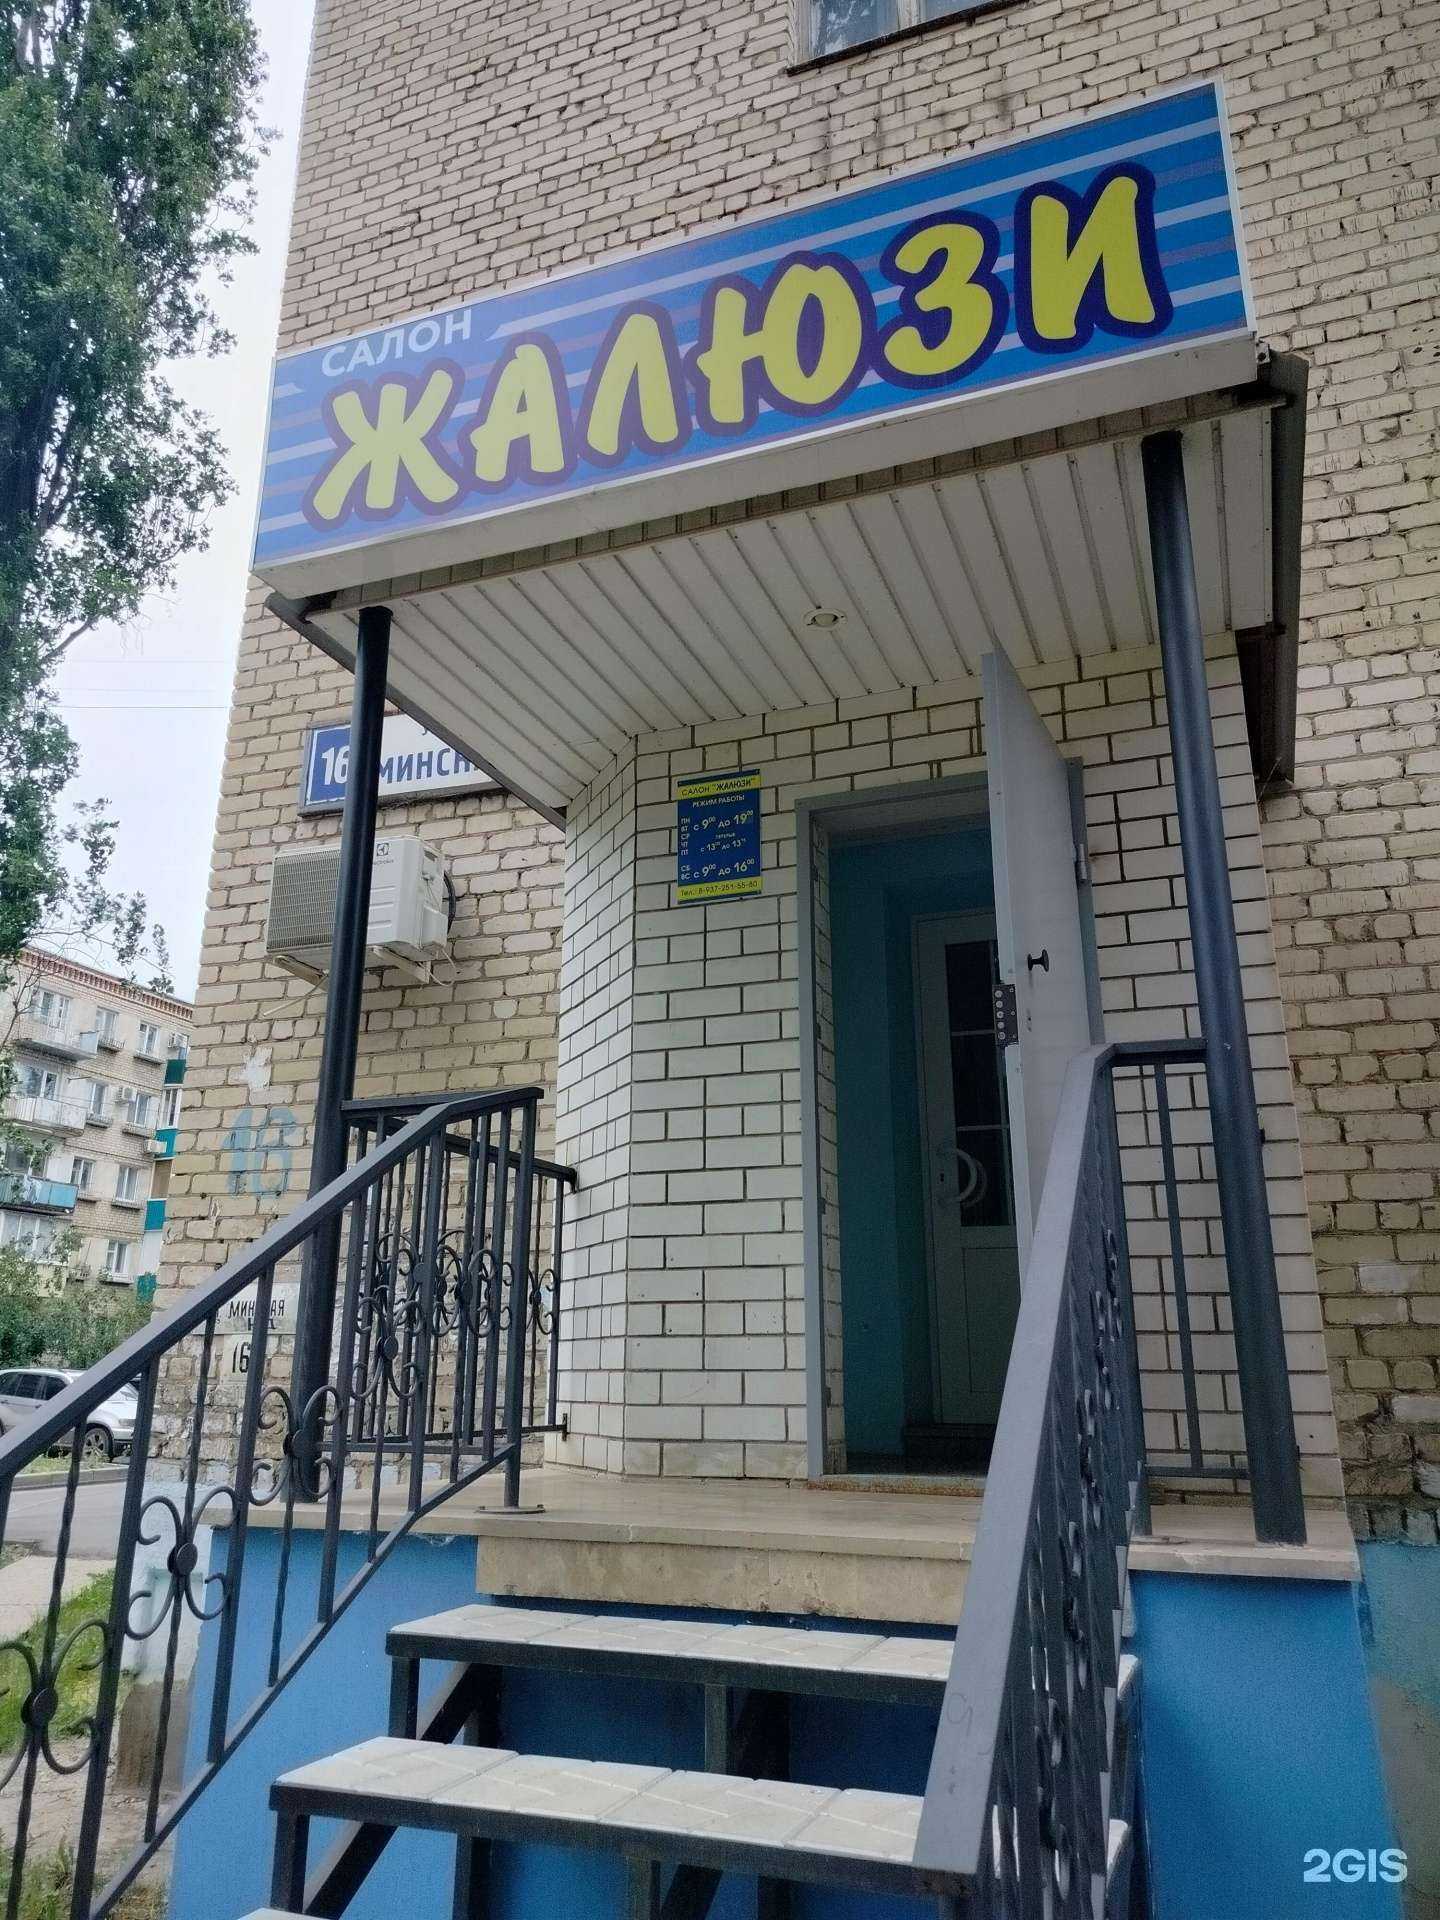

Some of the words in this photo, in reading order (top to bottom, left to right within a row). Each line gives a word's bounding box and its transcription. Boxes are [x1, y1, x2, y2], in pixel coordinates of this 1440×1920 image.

[307, 167, 1167, 526] ЖАЛЮЗИ
[322, 308, 472, 377] САЛОН
[321, 744, 350, 786] 16
[682, 787, 709, 796] САЛОН
[228, 1299, 285, 1319] МИНАЯ
